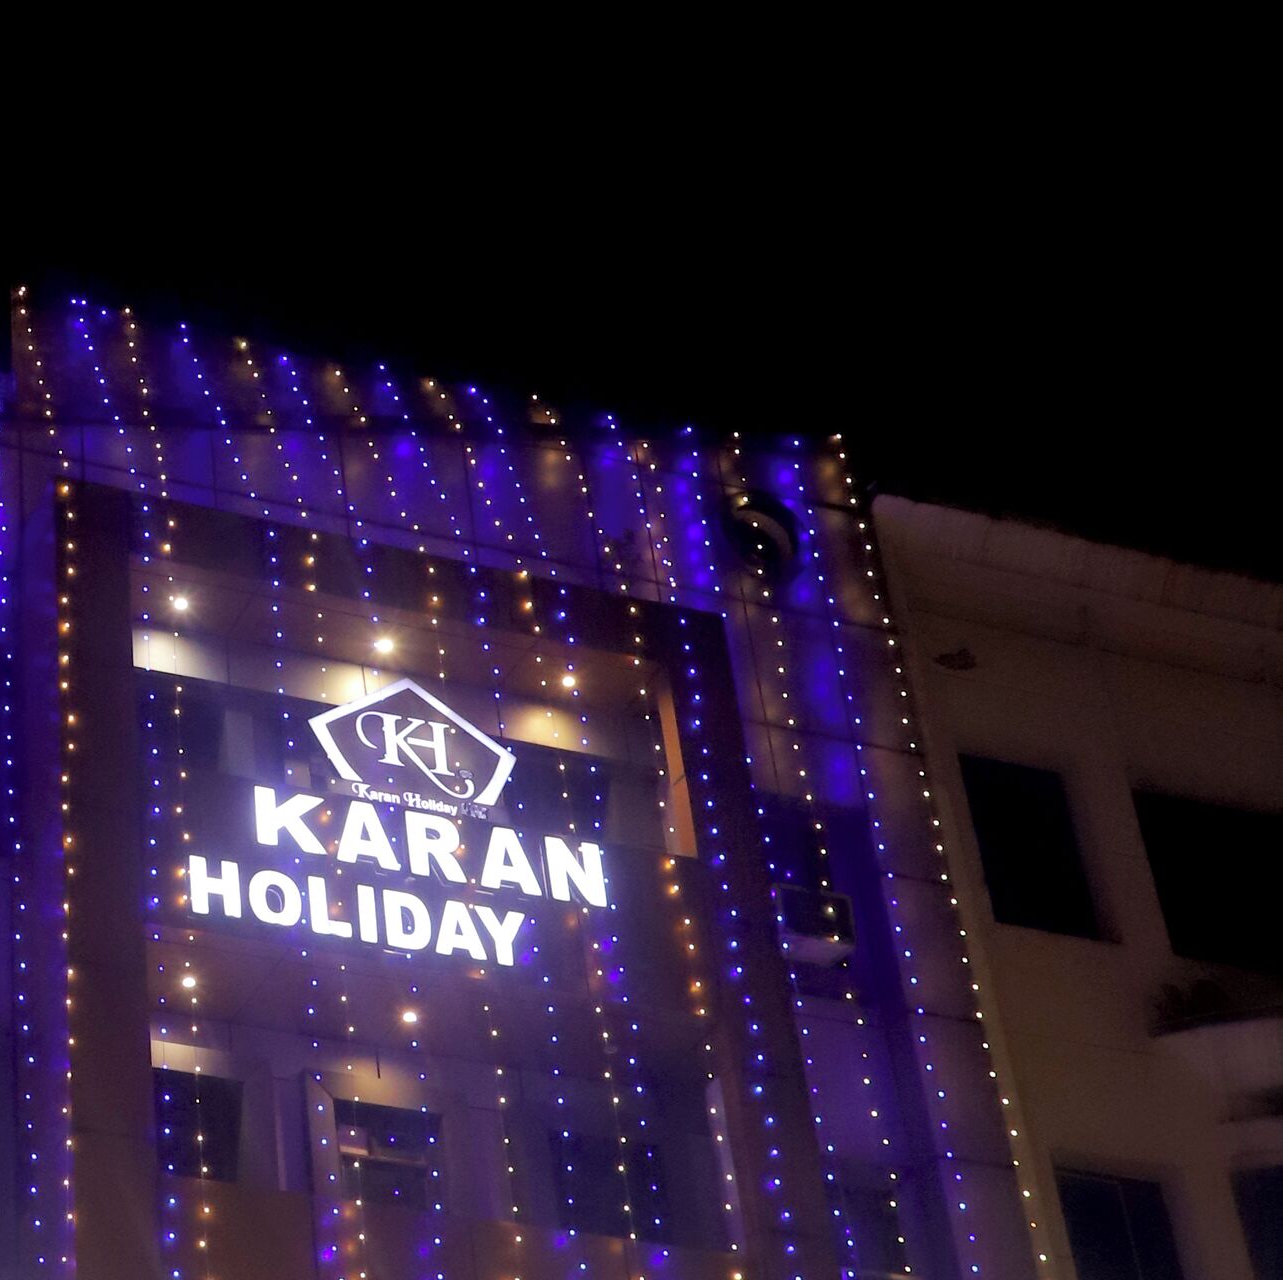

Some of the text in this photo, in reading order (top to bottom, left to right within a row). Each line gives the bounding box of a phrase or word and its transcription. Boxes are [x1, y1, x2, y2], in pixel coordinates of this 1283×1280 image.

[252, 785, 608, 908] KARAN
[351, 782, 401, 804] Karan
[403, 791, 458, 816] Holiday
[187, 853, 526, 968] HOLIDAY
